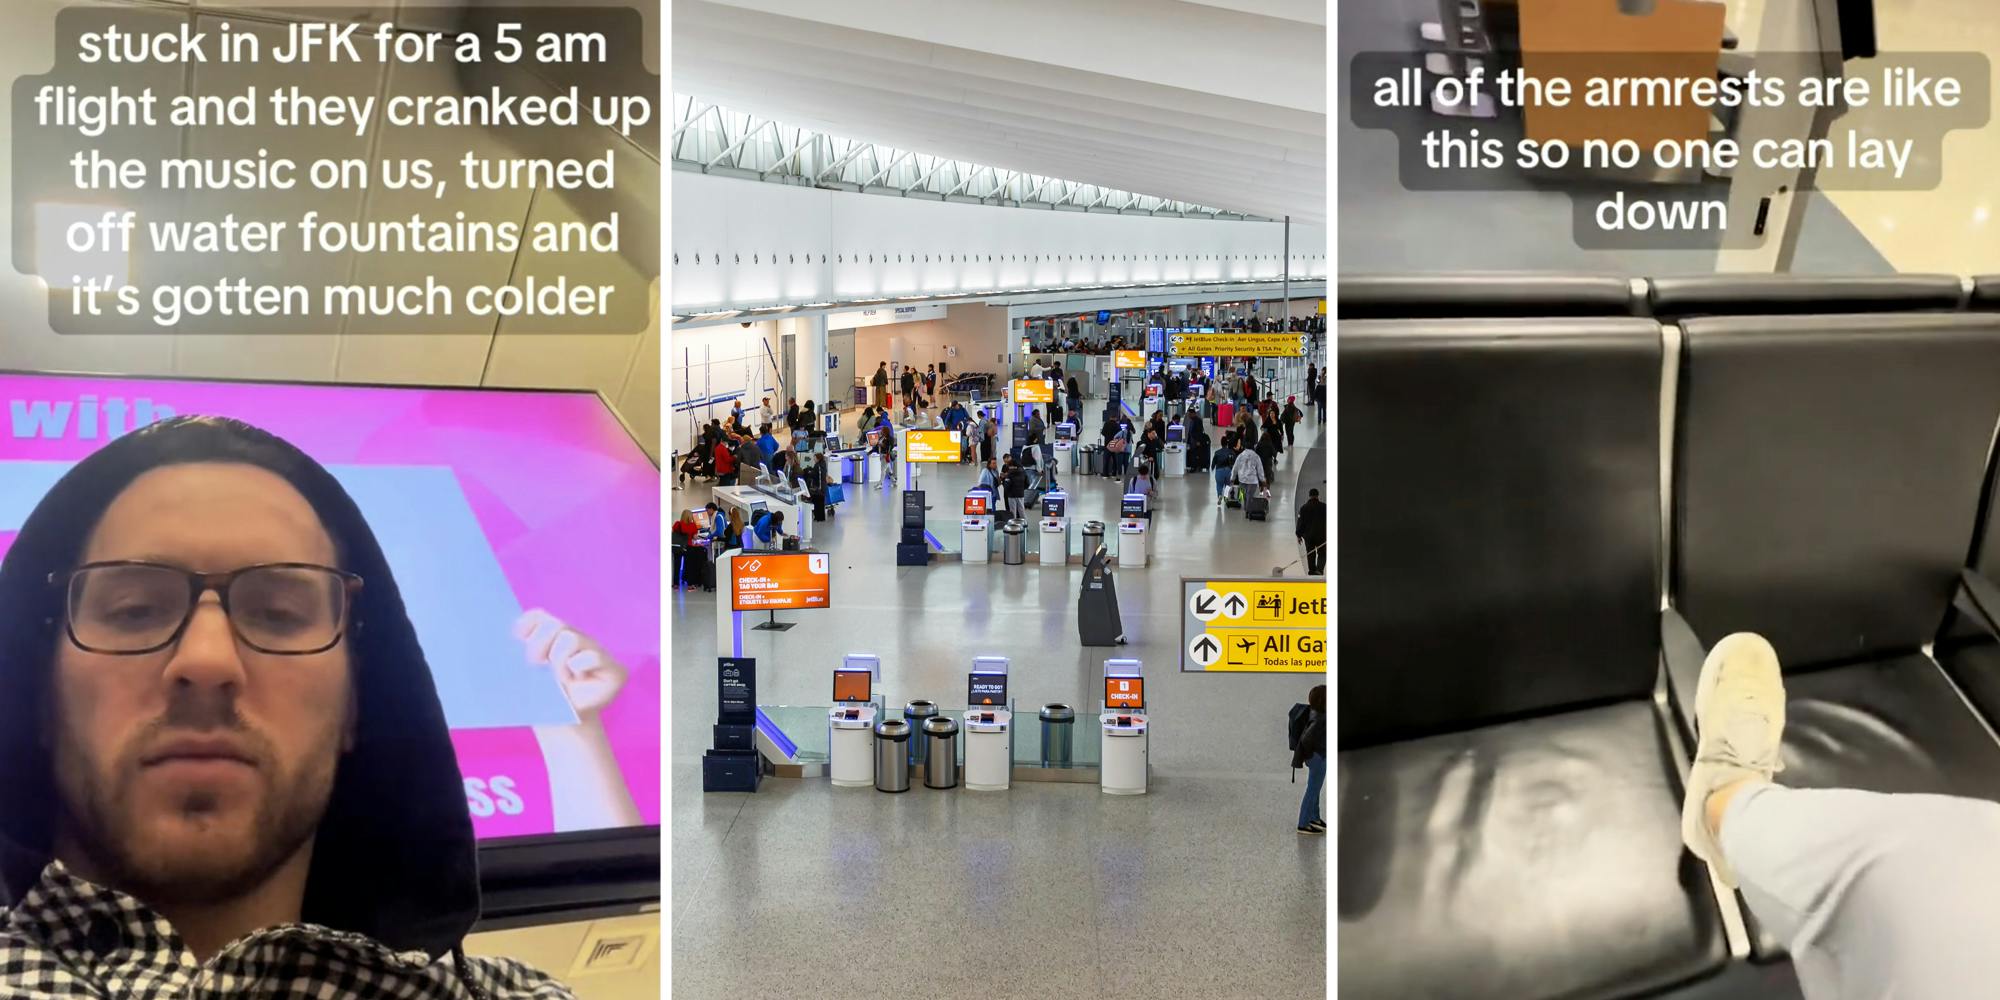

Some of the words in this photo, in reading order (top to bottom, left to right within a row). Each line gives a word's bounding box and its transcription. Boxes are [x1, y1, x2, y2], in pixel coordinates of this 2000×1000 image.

[828, 352, 839, 369] lue
[816, 558, 822, 569] 1
[1264, 634, 1290, 653] All
[1297, 635, 1327, 653] Ga
[1264, 658, 1288, 666] Todas
[1291, 657, 1303, 666] las
[1305, 659, 1327, 668] puer
